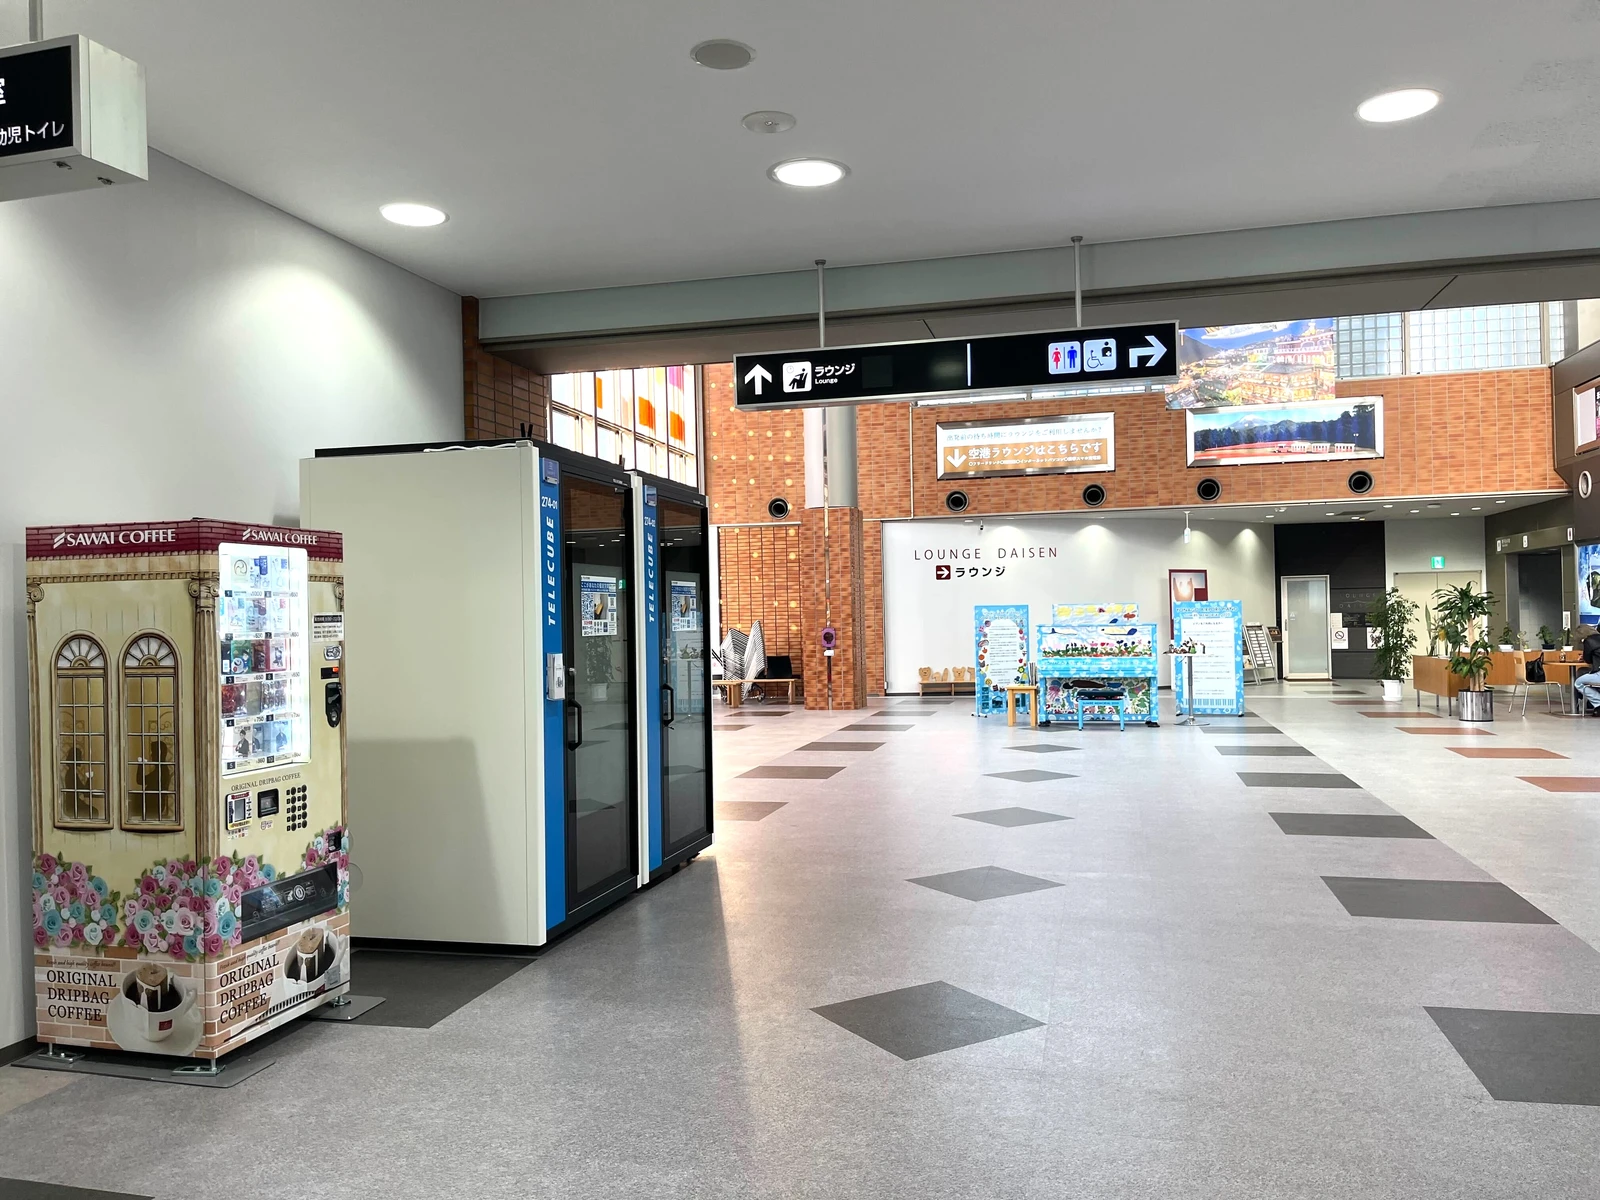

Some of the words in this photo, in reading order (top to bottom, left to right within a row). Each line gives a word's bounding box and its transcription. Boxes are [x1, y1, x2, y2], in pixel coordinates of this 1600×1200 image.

[814, 363, 856, 377] ラウンジ
[968, 441, 1103, 459] 空港ラウンジはこちらです
[541, 496, 557, 509] 274-01
[67, 531, 115, 547] SAWAI
[118, 528, 176, 544] COFFEE
[251, 529, 283, 542] SAWAI
[285, 533, 318, 545] COFFEE
[914, 548, 981, 560] LOUNGE
[997, 547, 1057, 559] DAISEN
[546, 516, 556, 626] TELECUBE
[647, 532, 655, 623] TELECUBE
[955, 566, 1006, 578] ラウンジ
[231, 780, 258, 792] ORIGINAL
[258, 776, 281, 786] DRIPBAG
[281, 772, 301, 781] COFFEE
[46, 969, 117, 987] ORIGINAL
[220, 954, 280, 988] ORIGINAL
[47, 987, 110, 1005] DRIPBAG
[220, 972, 274, 1007] DRIPBAG
[48, 1004, 102, 1021] COFFEE
[220, 992, 267, 1024] COFFEE
